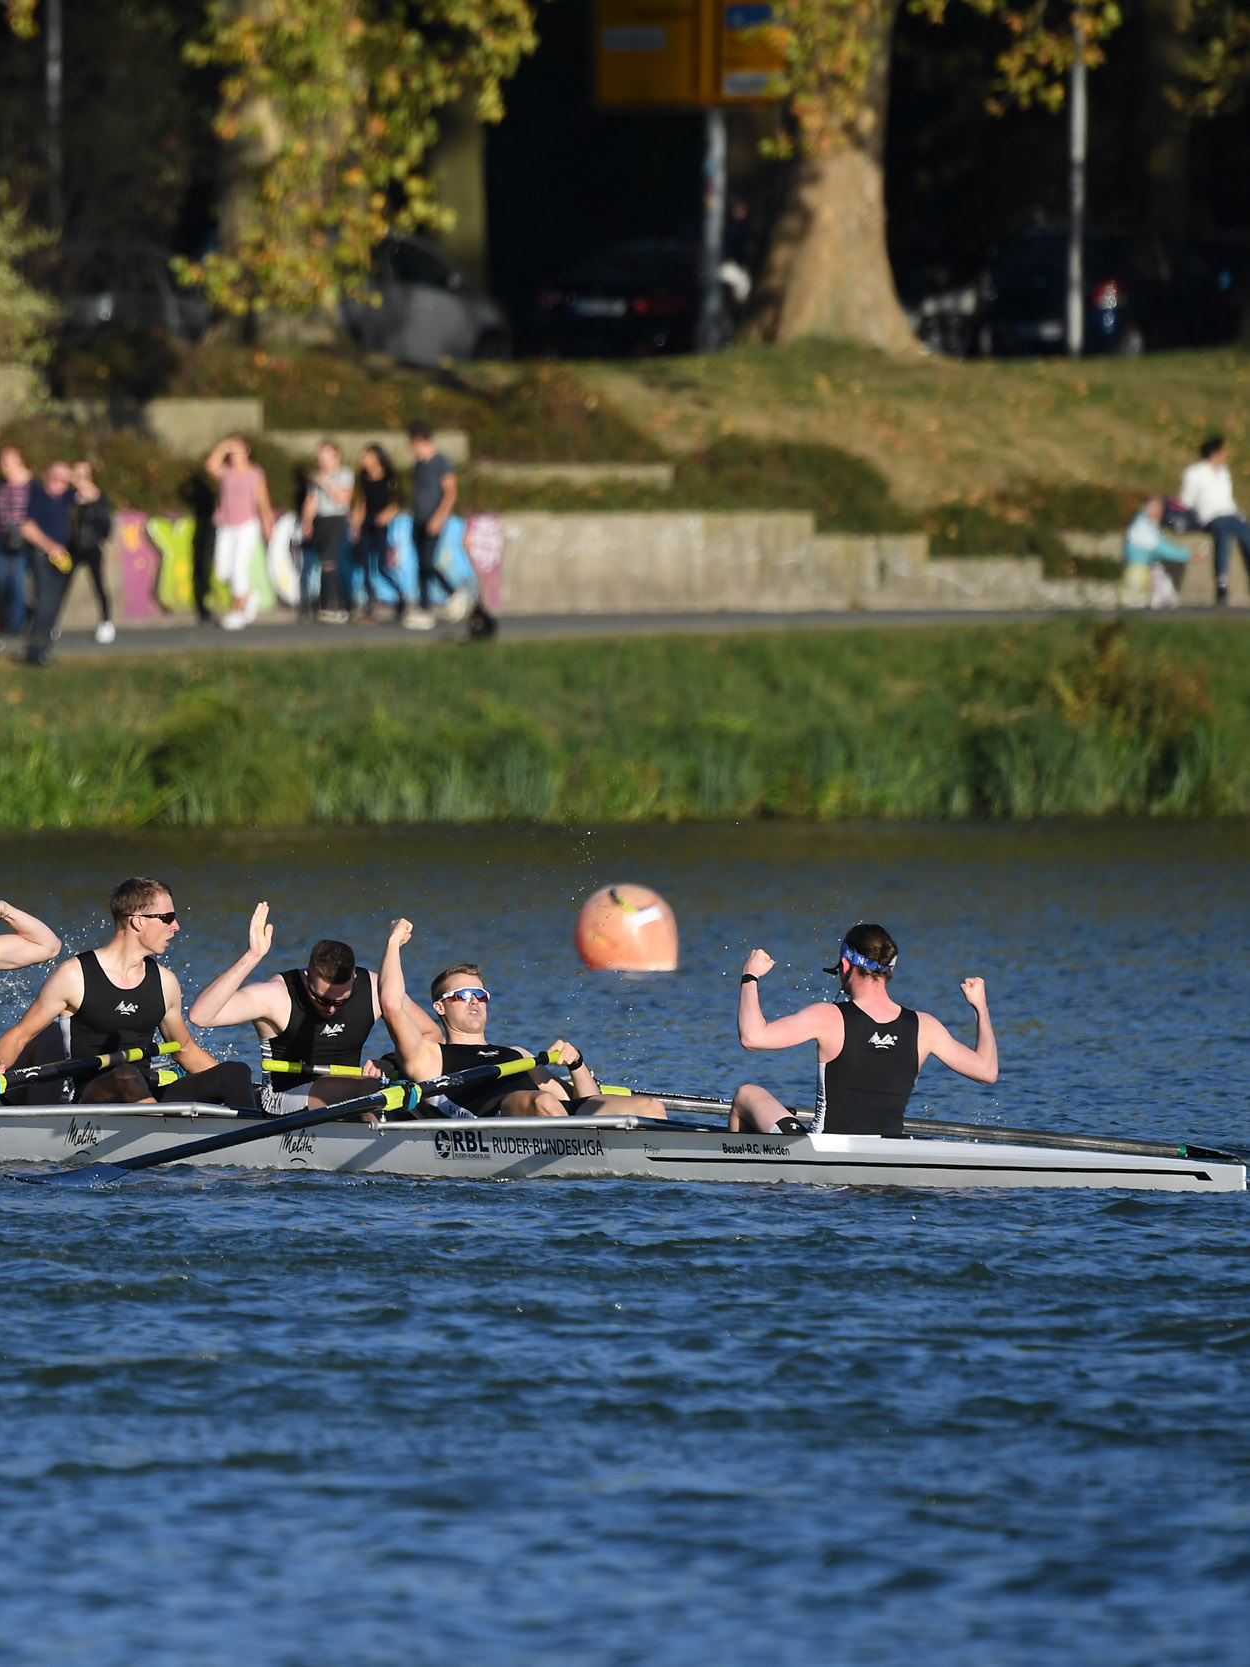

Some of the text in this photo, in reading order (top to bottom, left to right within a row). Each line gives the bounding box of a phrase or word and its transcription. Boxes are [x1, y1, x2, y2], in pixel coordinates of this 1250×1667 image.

[63, 1116, 100, 1147] Melitta
[278, 1128, 316, 1154] Melitta
[453, 1130, 489, 1153] RBL
[492, 1136, 605, 1156] RUDER-BUNDESLIGA
[721, 1142, 791, 1156] Bessel-R.C. Minden
